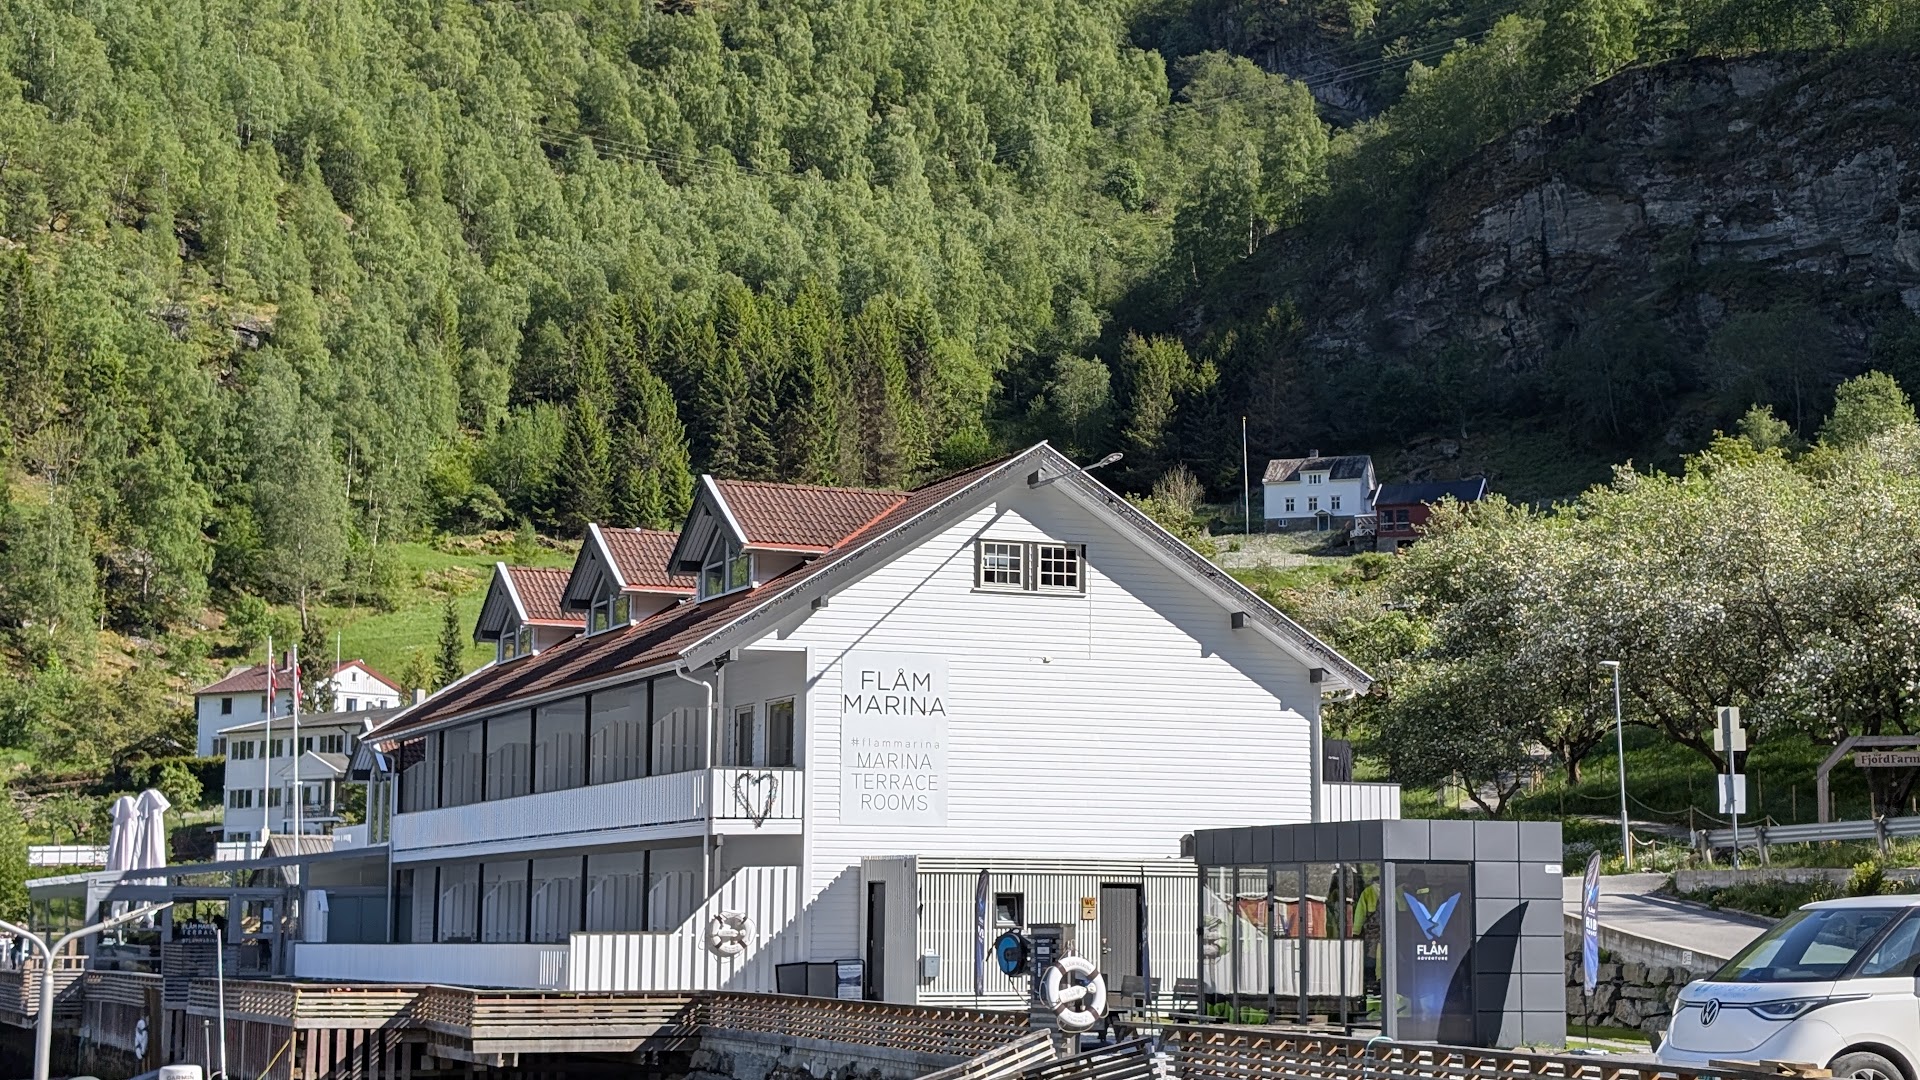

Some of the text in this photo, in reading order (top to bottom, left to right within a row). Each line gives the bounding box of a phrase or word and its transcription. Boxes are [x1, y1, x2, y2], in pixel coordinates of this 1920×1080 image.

[861, 668, 930, 692] FLÅM
[844, 694, 946, 716] MARINA
[851, 737, 940, 749] #flammarina
[857, 753, 932, 770] MARINA
[851, 773, 938, 791] TERRACE
[861, 794, 928, 811] ROOMS
[1416, 941, 1448, 955] FLÅM
